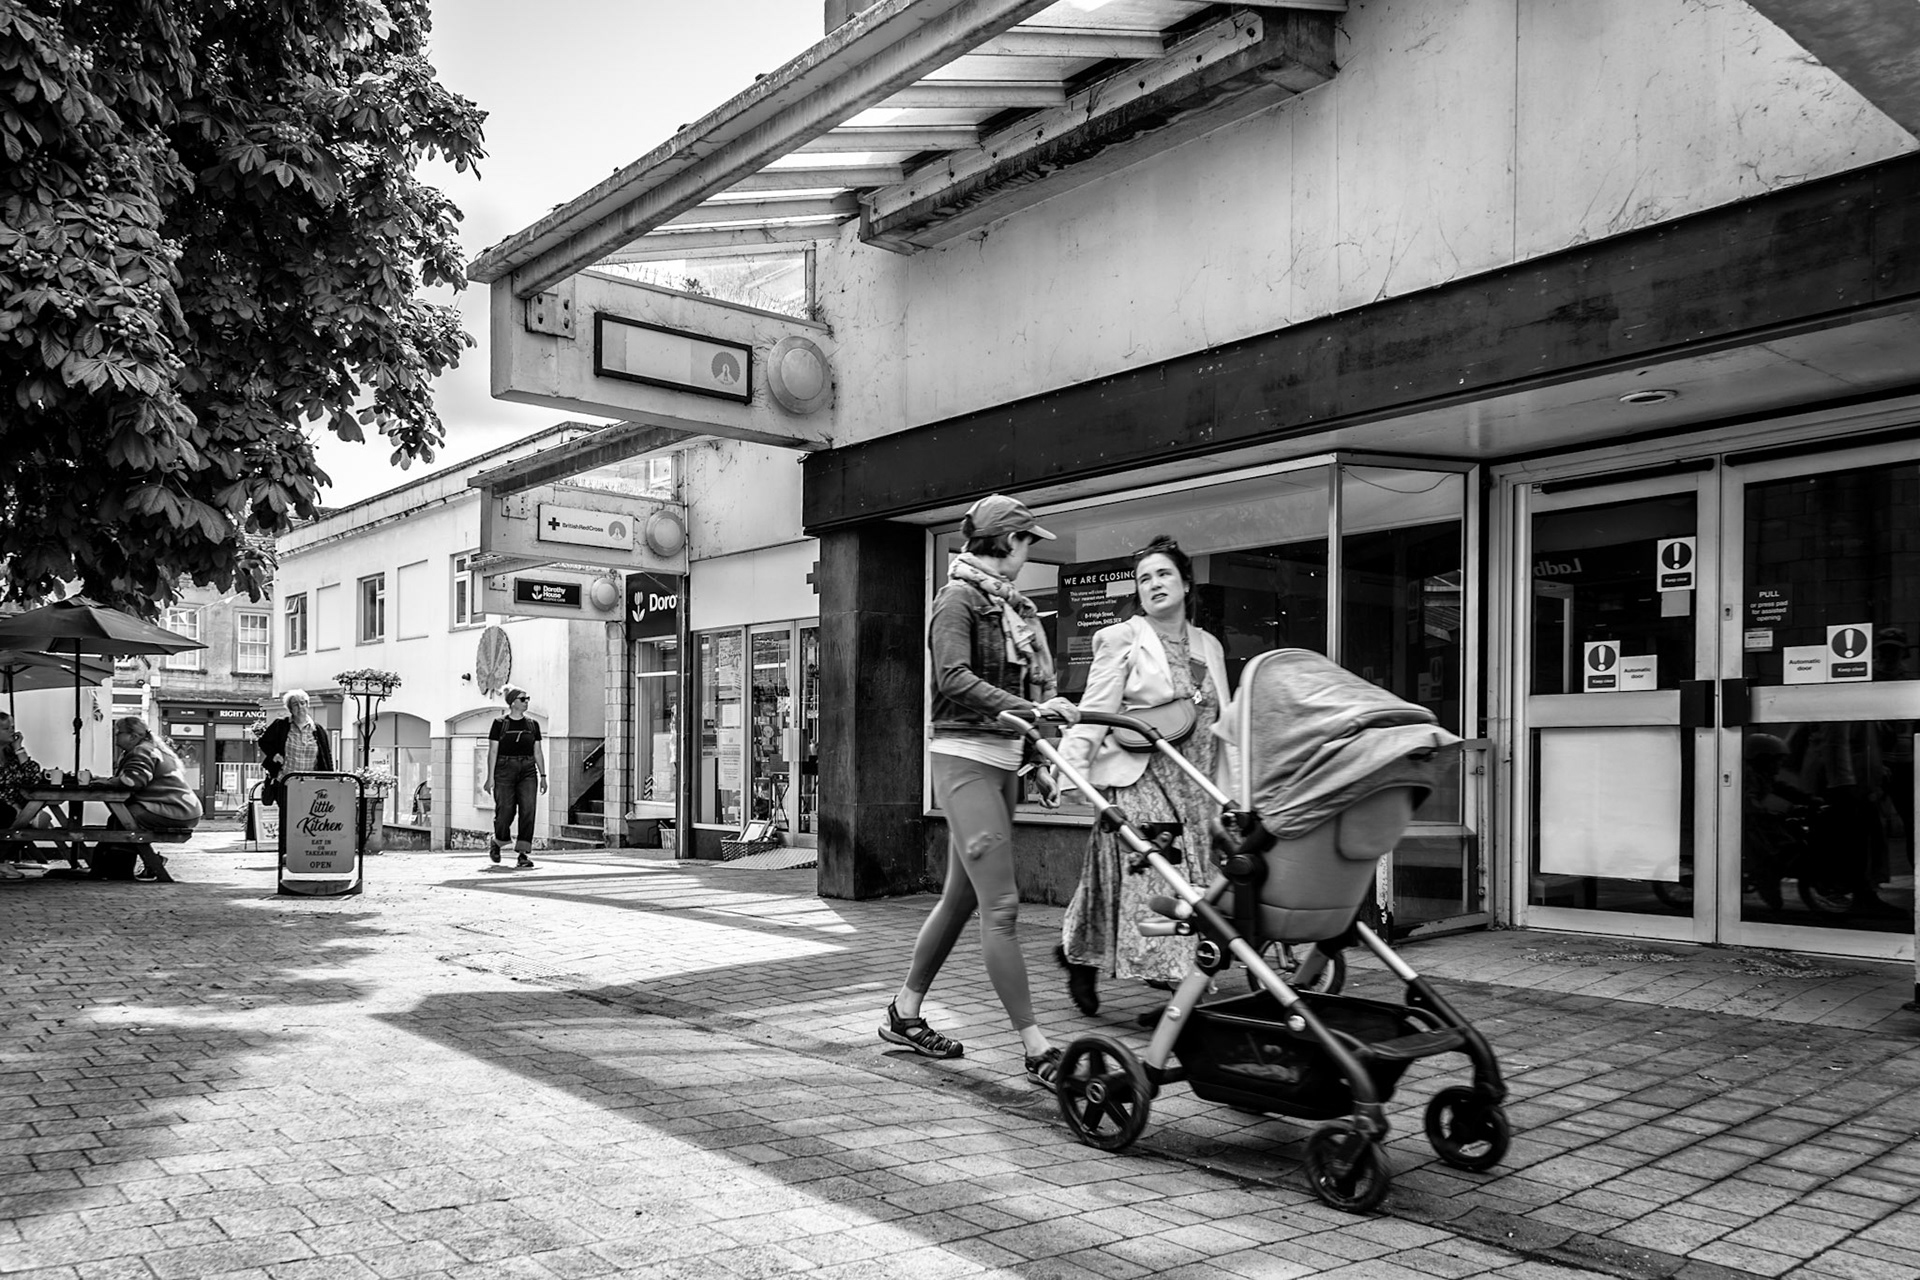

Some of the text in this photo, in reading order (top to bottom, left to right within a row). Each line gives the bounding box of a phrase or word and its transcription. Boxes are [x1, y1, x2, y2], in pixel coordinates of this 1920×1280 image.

[1064, 577, 1077, 585] WE
[1080, 575, 1097, 584] ARE
[543, 585, 566, 595] Dorothy
[650, 593, 678, 612] Doro
[1761, 607, 1787, 615] assisted
[220, 710, 245, 718] RIGHT
[314, 788, 329, 800] The
[309, 799, 336, 818] Little
[296, 817, 344, 837] Kitchen
[309, 861, 332, 869] OPEN
